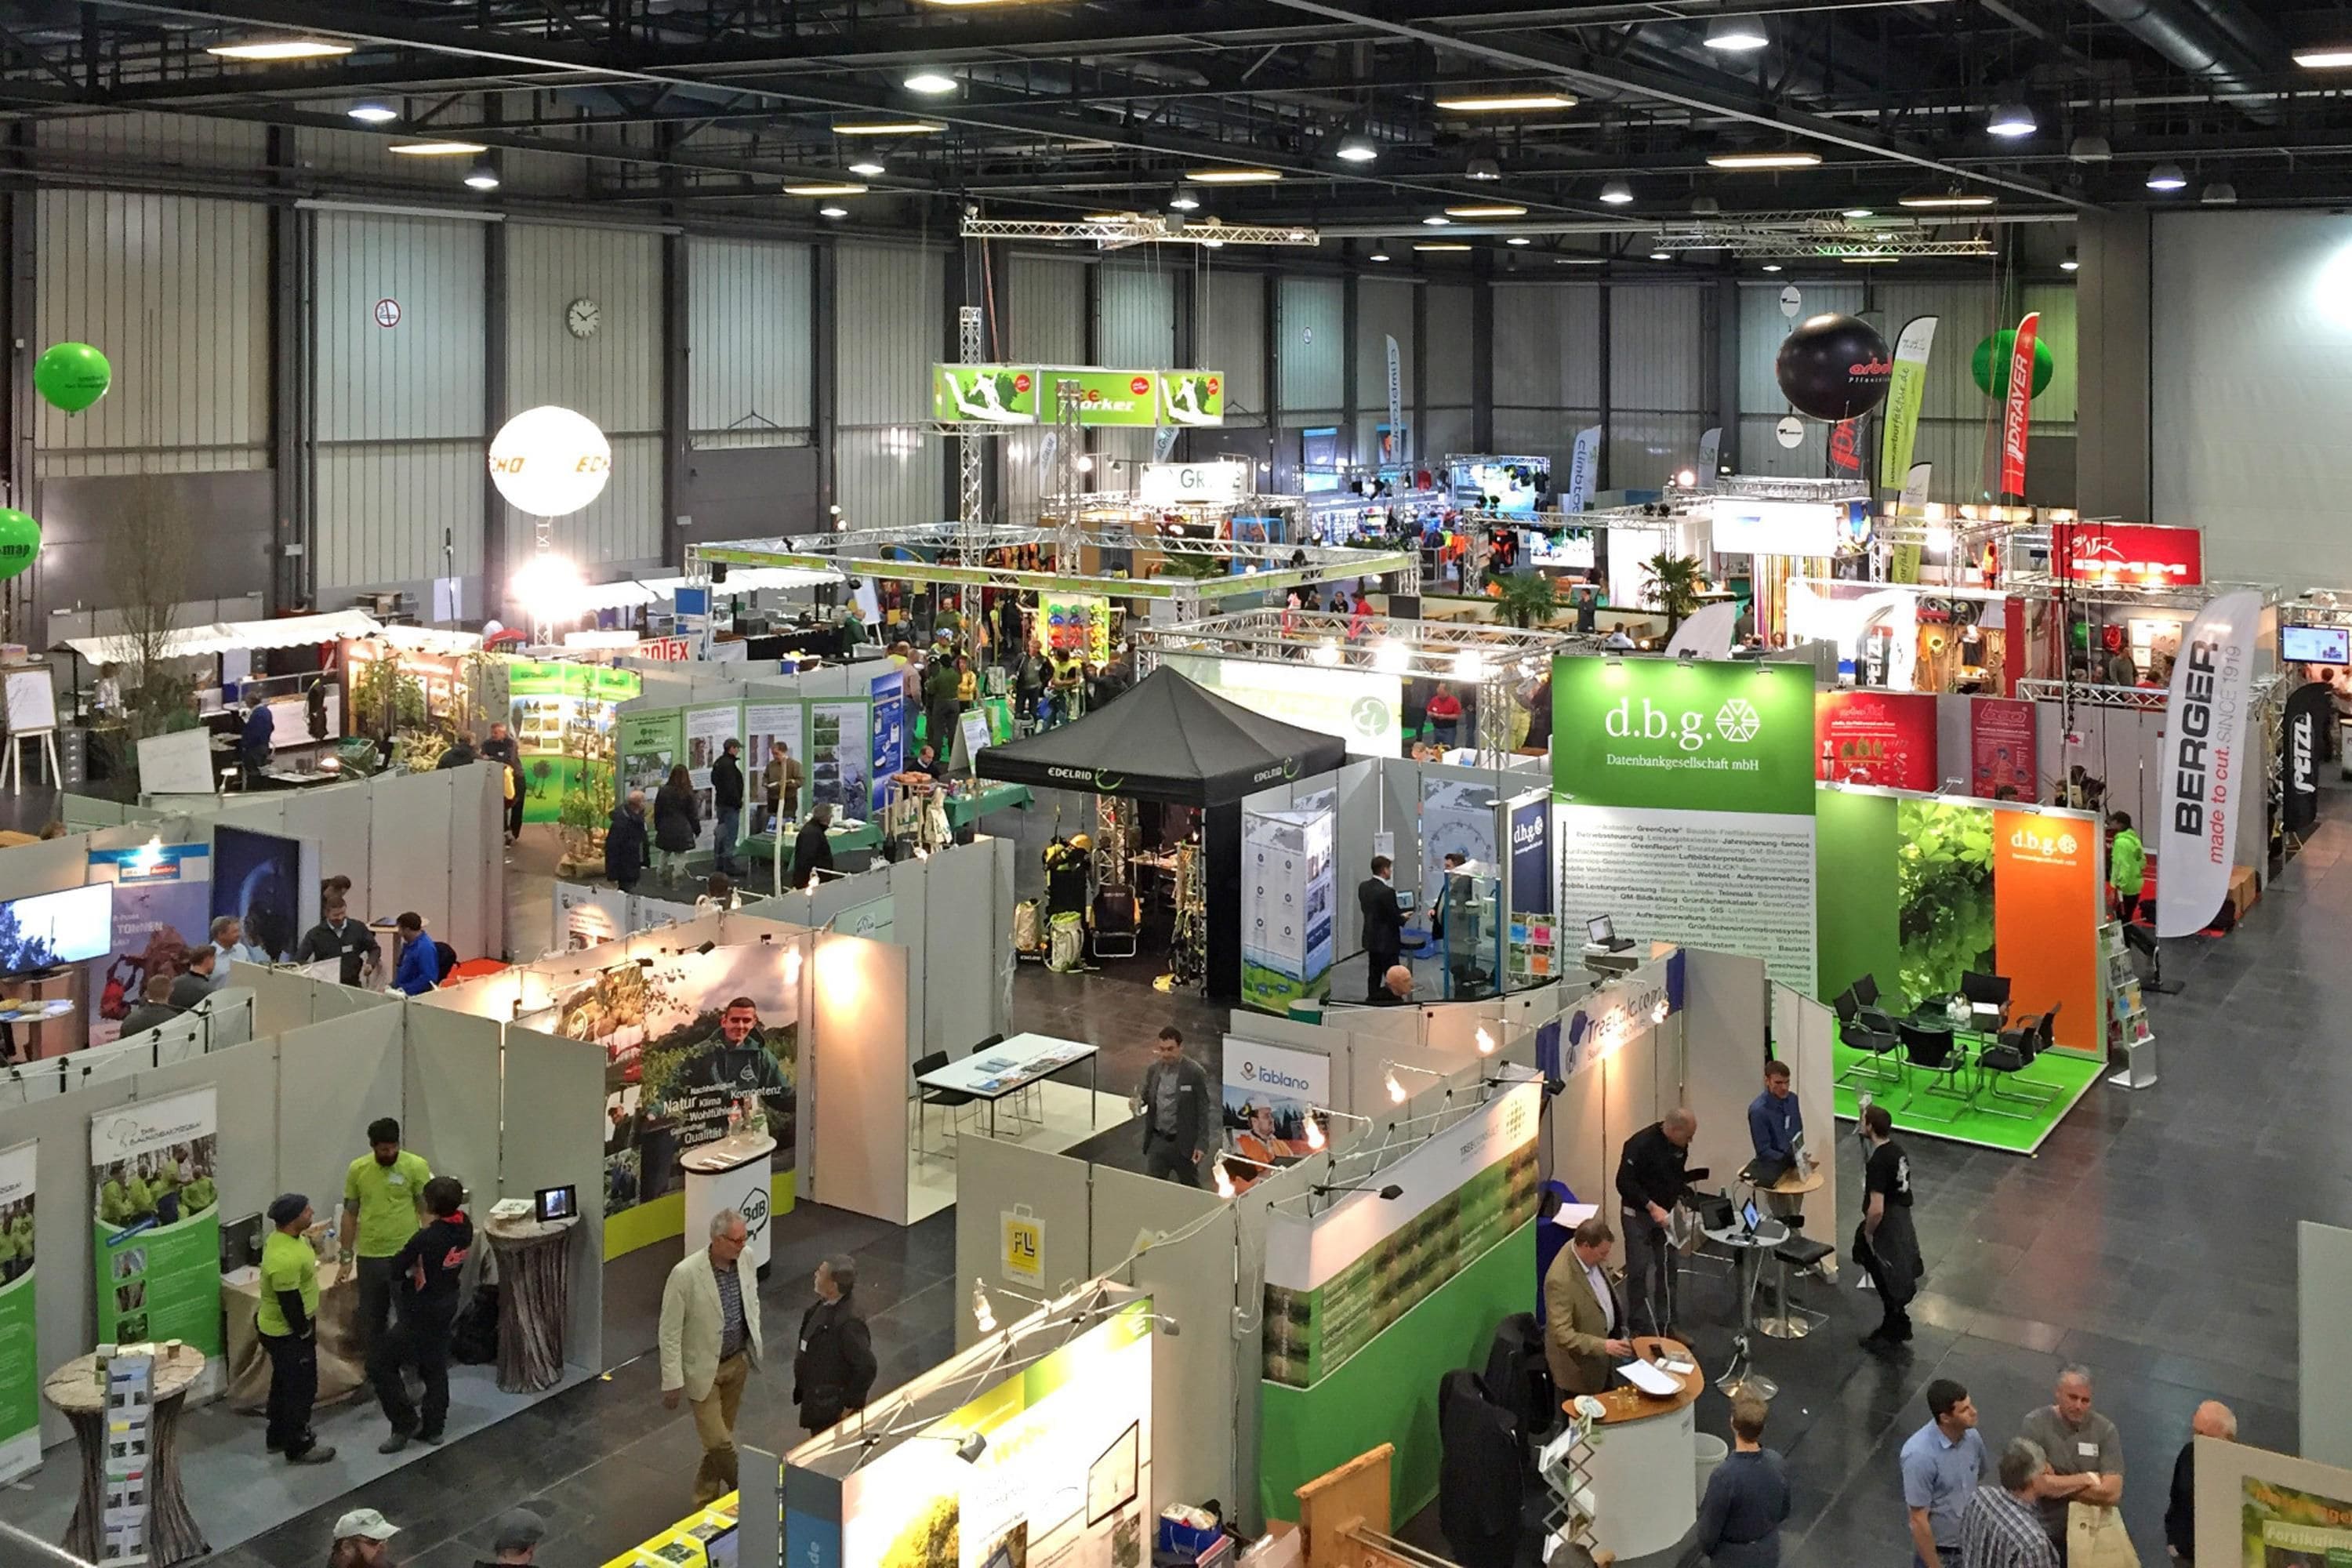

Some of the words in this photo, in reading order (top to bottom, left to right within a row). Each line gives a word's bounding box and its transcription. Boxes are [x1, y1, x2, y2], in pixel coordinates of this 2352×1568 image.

[2007, 353, 2028, 449] DRAYER
[2072, 558, 2187, 575] DMM
[2222, 645, 2241, 684] 1919
[1605, 696, 1712, 751] d.b.g.
[2216, 688, 2234, 743] SINCE
[2174, 640, 2220, 837] BERGER
[1606, 753, 1729, 770] Datenbankgesellschaft
[1731, 759, 1759, 771] mbH
[2293, 711, 2316, 794] PETZL
[1047, 767, 1092, 781] EDELRID
[1254, 766, 1283, 782] EDELRID
[2211, 785, 2227, 804] to
[2210, 808, 2225, 864] made
[1258, 1065, 1309, 1091] Tablano
[730, 1086, 782, 1099] Kompetenz
[663, 1097, 697, 1115] Natur
[699, 1097, 721, 1107] Klima
[684, 1127, 722, 1145] Qualität
